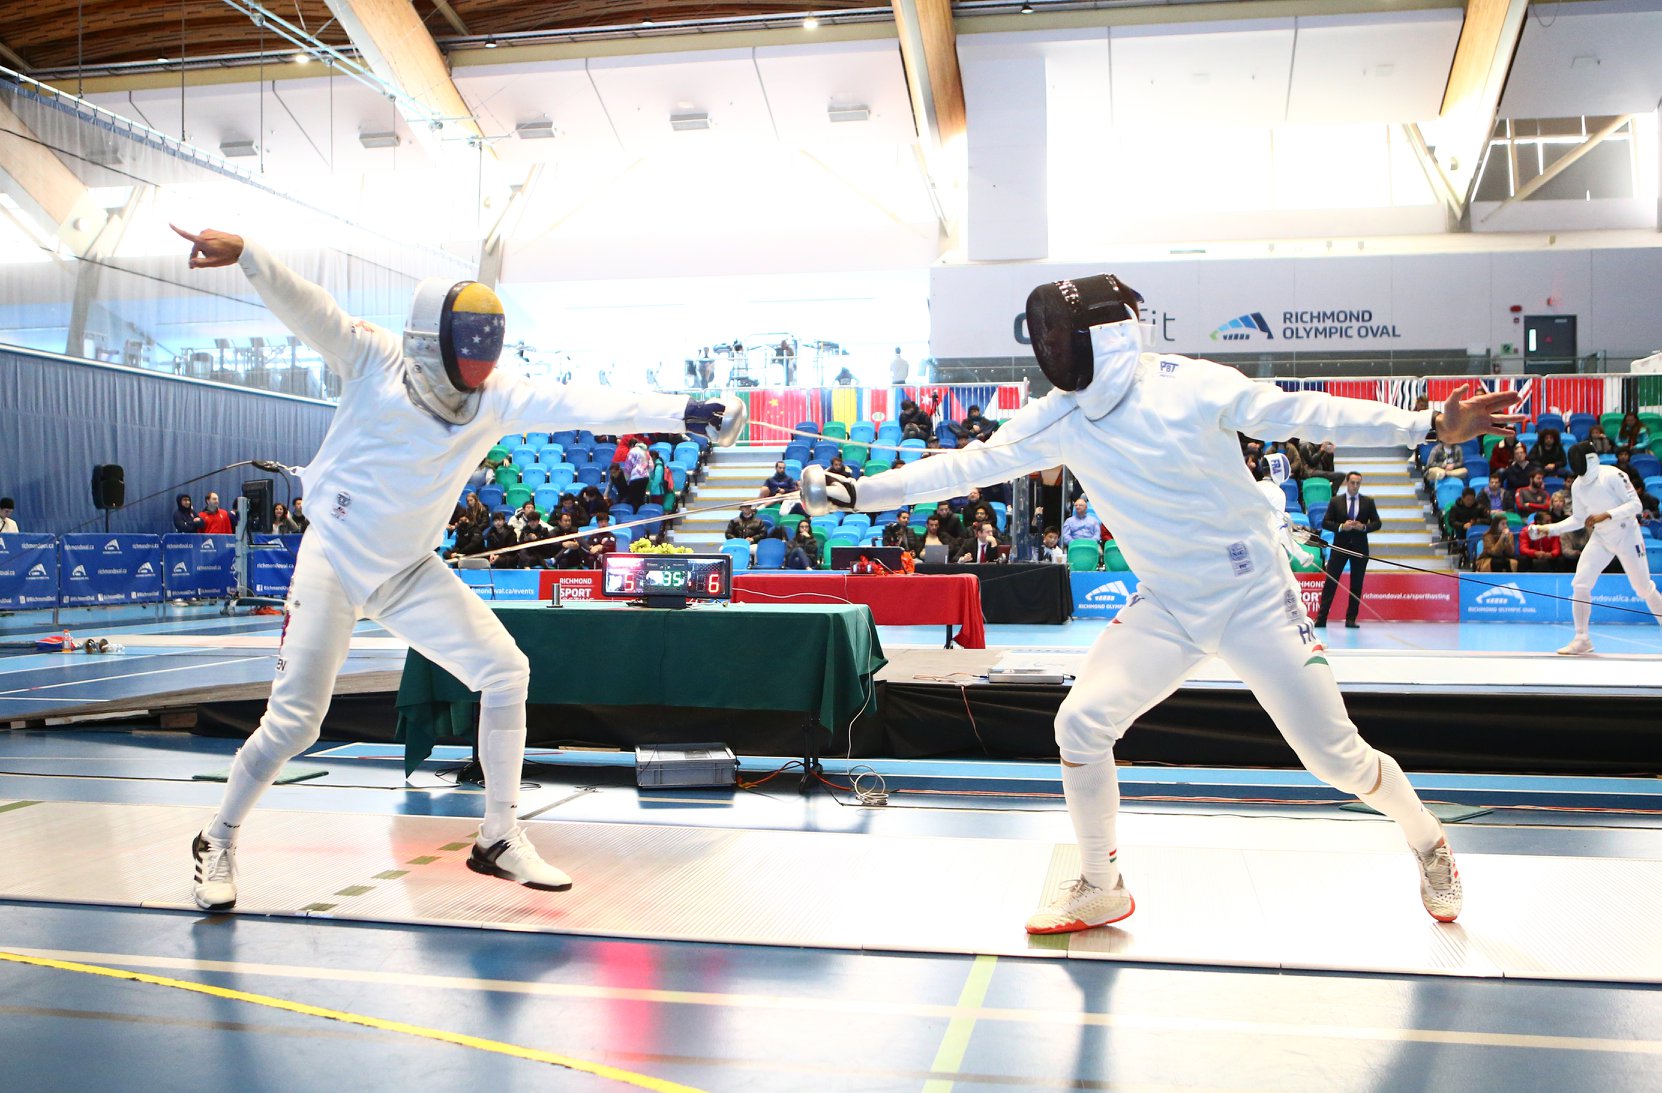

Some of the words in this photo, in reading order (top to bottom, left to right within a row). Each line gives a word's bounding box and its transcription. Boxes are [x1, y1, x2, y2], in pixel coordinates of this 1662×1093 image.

[1282, 310, 1373, 324] RICHMOND
[1282, 325, 1354, 340] OLYMPIC
[1357, 324, 1402, 338] OVAL
[559, 577, 593, 585] RICHMOND
[707, 573, 720, 593] 6
[559, 588, 593, 598] SPORT
[1362, 592, 1451, 601] richmondoval.ca/sporthosting
